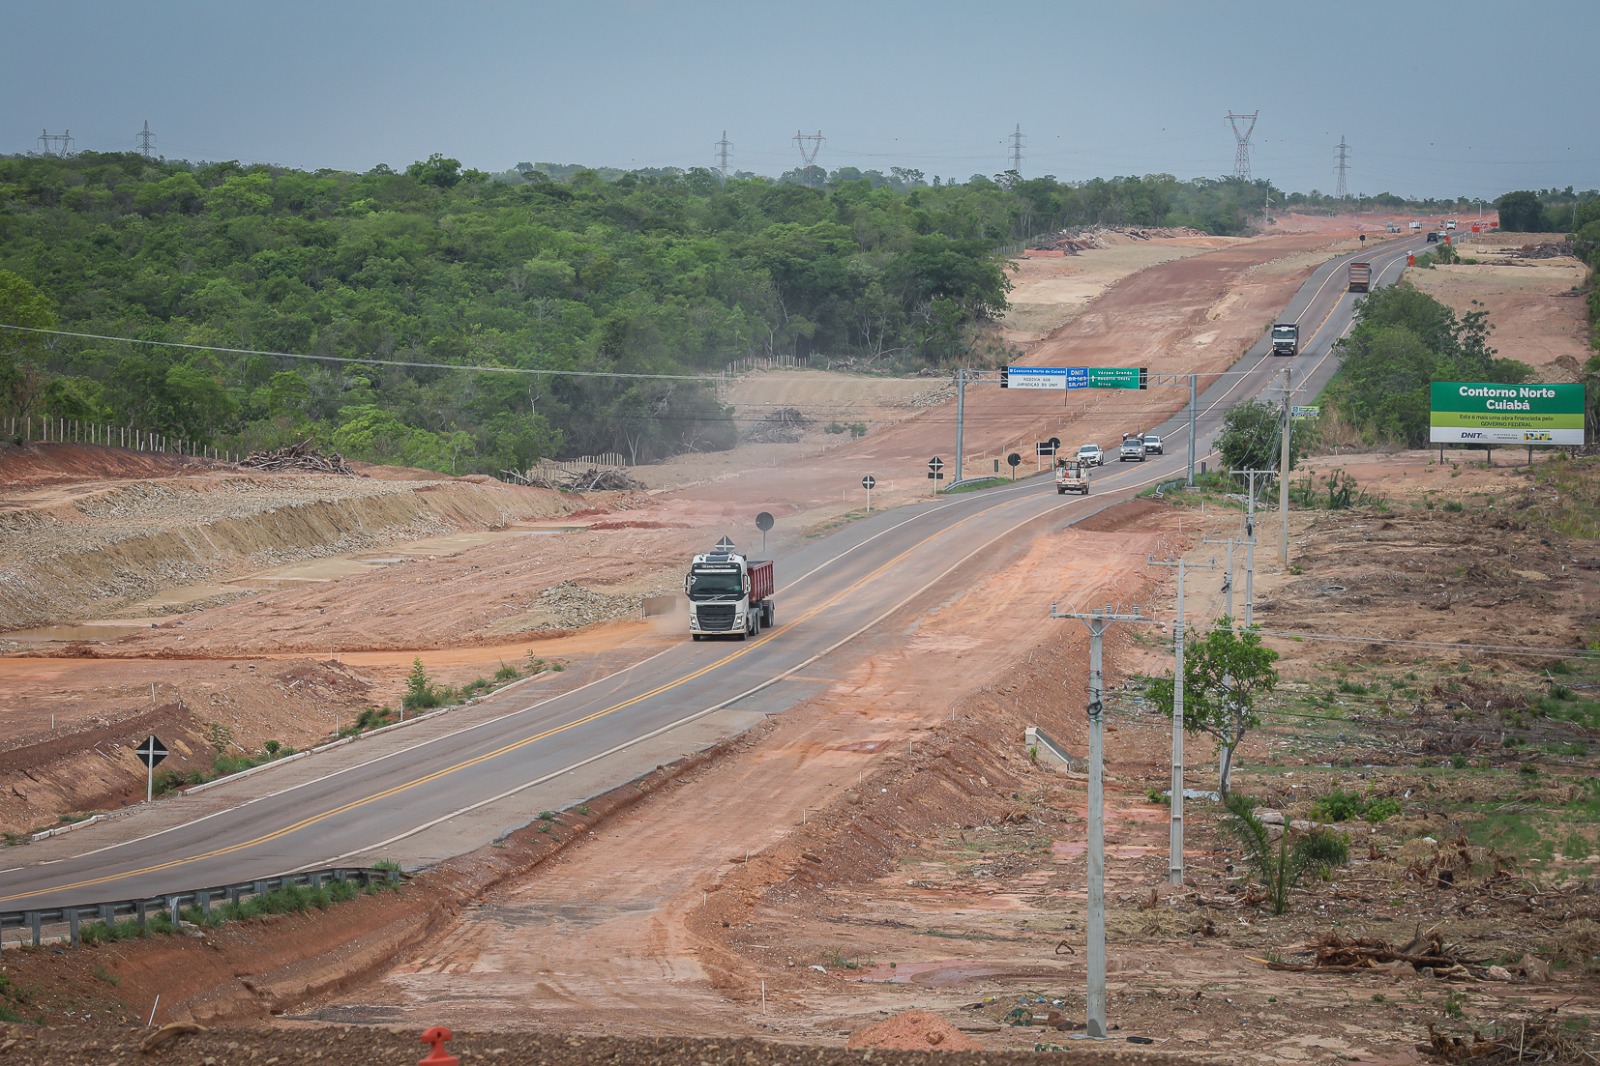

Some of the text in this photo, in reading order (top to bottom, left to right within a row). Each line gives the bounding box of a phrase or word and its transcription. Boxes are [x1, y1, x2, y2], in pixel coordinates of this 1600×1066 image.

[1459, 386, 1556, 398] Contorno Norte
[1486, 400, 1530, 410] Cuiabá
